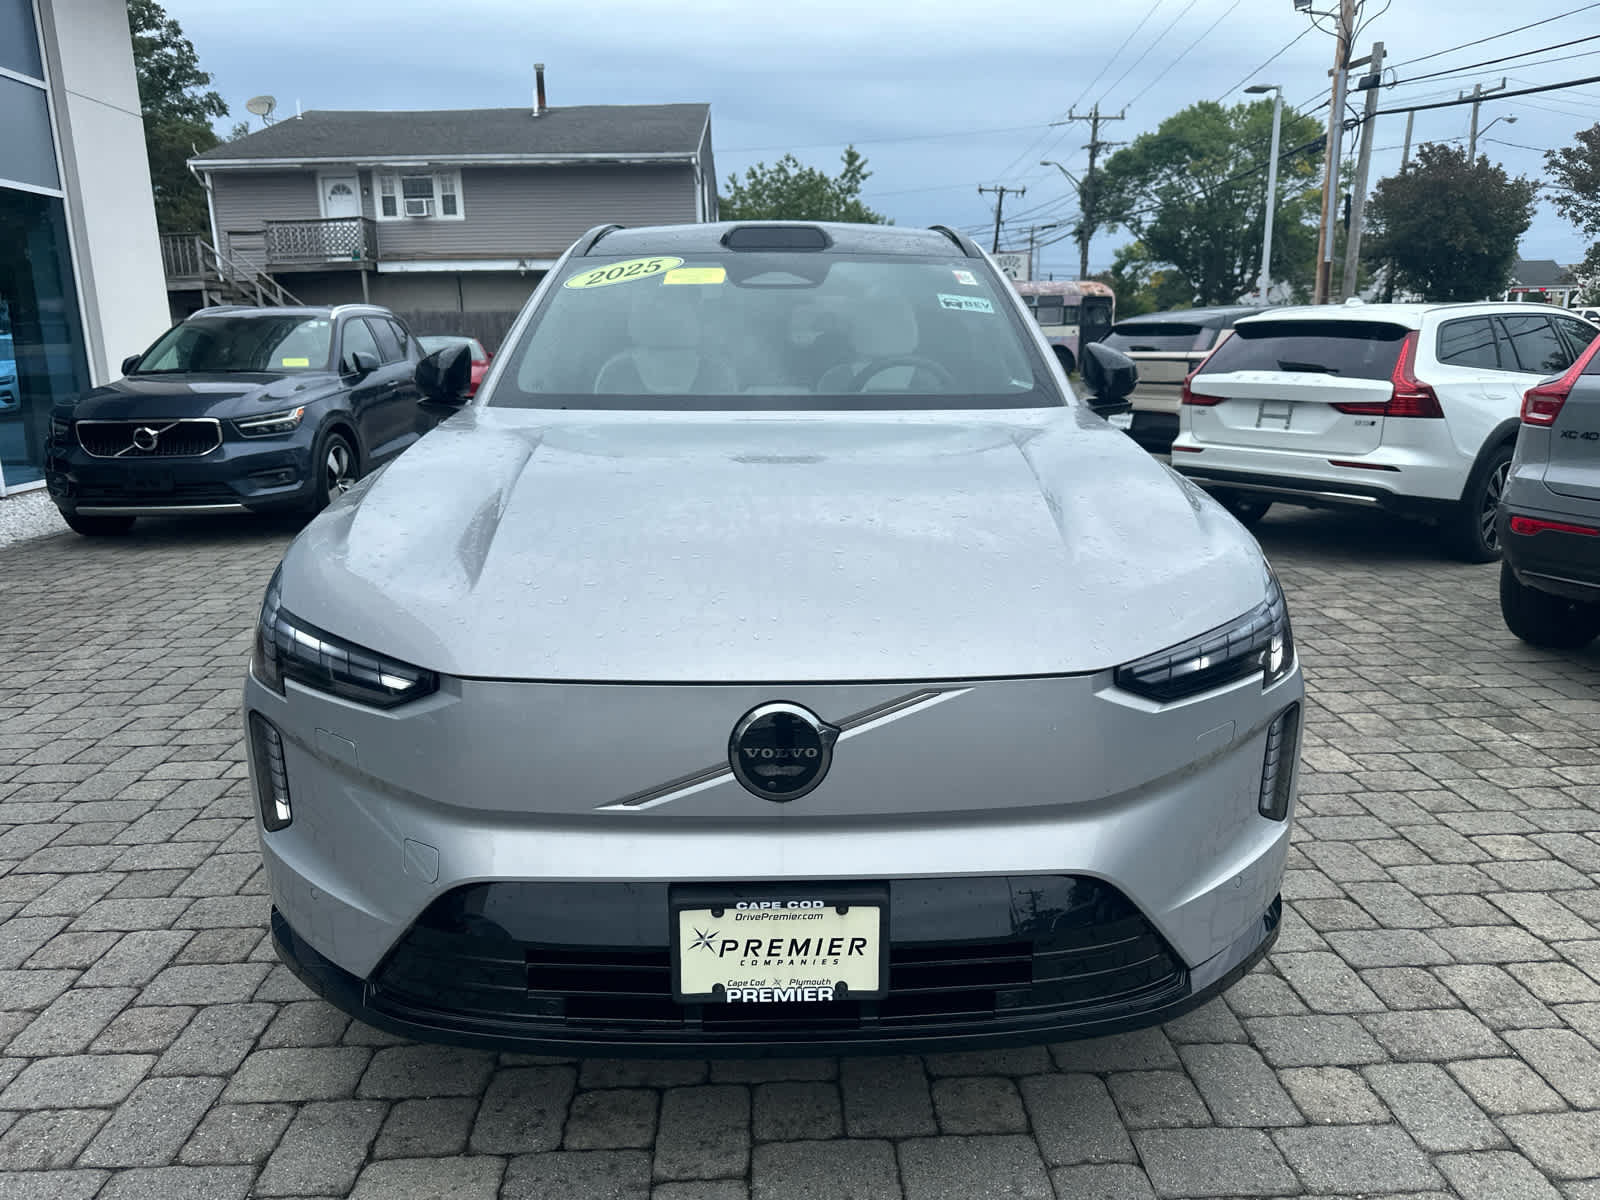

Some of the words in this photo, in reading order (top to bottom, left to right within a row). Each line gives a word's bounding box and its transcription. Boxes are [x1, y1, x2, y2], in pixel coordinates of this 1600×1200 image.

[585, 259, 664, 286] 2025
[1560, 430, 1579, 440] XC
[1580, 431, 1600, 441] 40
[743, 747, 818, 759] VOLVO
[735, 900, 782, 911] CAPE
[787, 900, 825, 910] COD
[735, 912, 824, 922] DrivePremier.com
[718, 937, 868, 958] PREMIER
[739, 958, 840, 967] COMPANIES
[727, 979, 749, 988] Cape
[750, 979, 766, 987] Cod
[789, 978, 832, 988] Plymouth
[726, 987, 834, 1004] PREMIER
